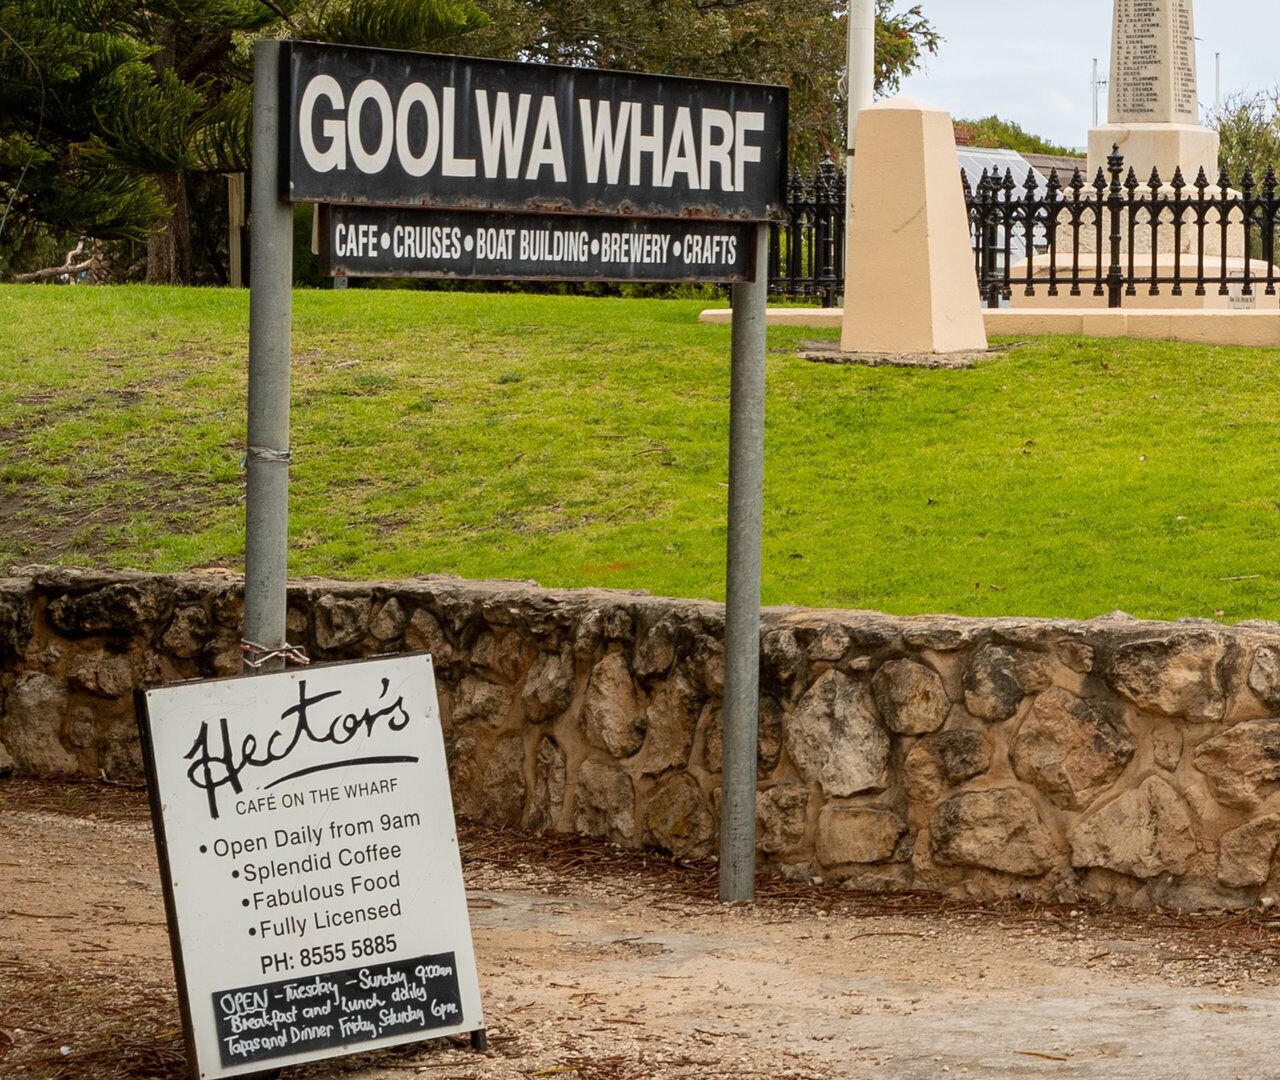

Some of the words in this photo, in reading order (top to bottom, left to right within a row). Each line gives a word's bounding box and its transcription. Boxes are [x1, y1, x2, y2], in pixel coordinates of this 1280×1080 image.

[299, 74, 567, 183] GOOLWA
[579, 98, 765, 193] WHARF
[335, 224, 378, 258] CAFE
[393, 225, 461, 261] CRUISES
[476, 228, 516, 261] BOAT
[520, 230, 589, 263] BUILDING
[601, 233, 671, 264] BREWERY
[683, 235, 737, 266] CRAFTS
[184, 677, 411, 819] Hector's
[235, 793, 277, 815] CAFÉ
[281, 792, 305, 809] ON
[311, 787, 339, 805] THE
[343, 778, 398, 800] WHARF
[213, 834, 268, 861] Open
[274, 823, 323, 850] Daily
[329, 819, 374, 840] from
[380, 811, 421, 831] 9am
[243, 853, 332, 885] Splendid
[338, 843, 402, 867] Coffee
[252, 881, 345, 911] Fabulous
[351, 870, 401, 895] Food
[260, 910, 307, 939] Fully
[314, 899, 402, 930] Licensed
[260, 954, 295, 974] PH:
[299, 943, 347, 968] 8555
[351, 933, 398, 959] 5885
[220, 989, 270, 1016] OPEN
[230, 1006, 298, 1034] Breakfast
[302, 1001, 332, 1019] and
[391, 983, 427, 1002] daily
[291, 1024, 334, 1043] Dinner
